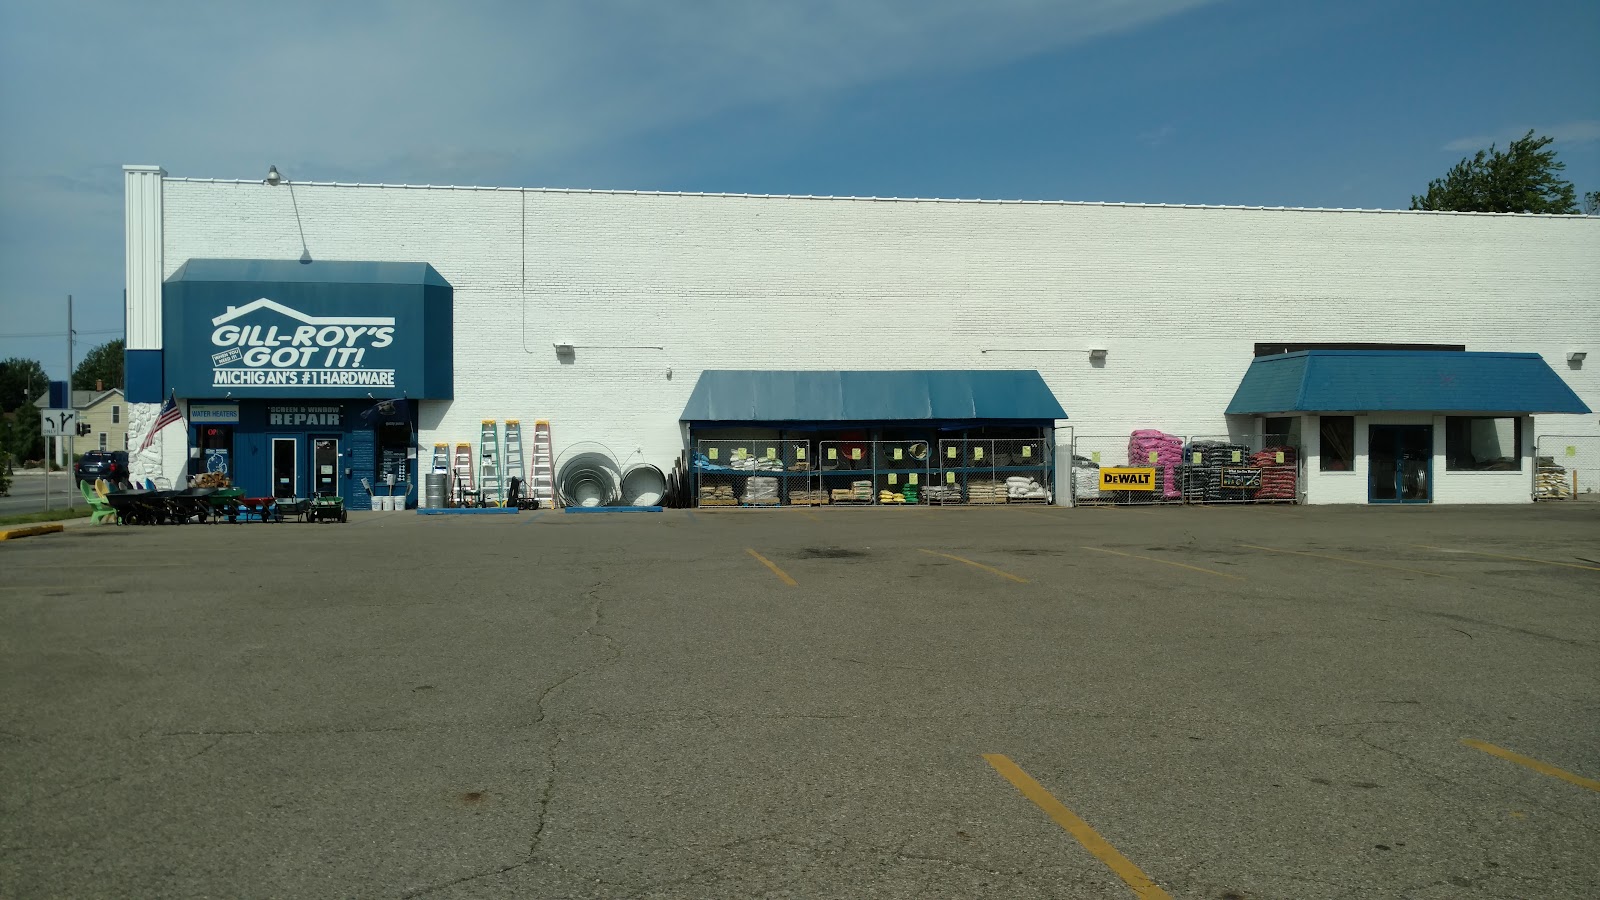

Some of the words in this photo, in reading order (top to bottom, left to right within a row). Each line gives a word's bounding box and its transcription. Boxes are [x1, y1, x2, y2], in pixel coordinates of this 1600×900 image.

[211, 325, 394, 347] GILL-ROY'S
[242, 347, 319, 367] GOT
[324, 347, 366, 367] IT!
[214, 371, 298, 385] MICHIGAN'S
[301, 371, 318, 385] #1
[321, 371, 395, 385] HARDWARE
[270, 413, 340, 426] REPAIR
